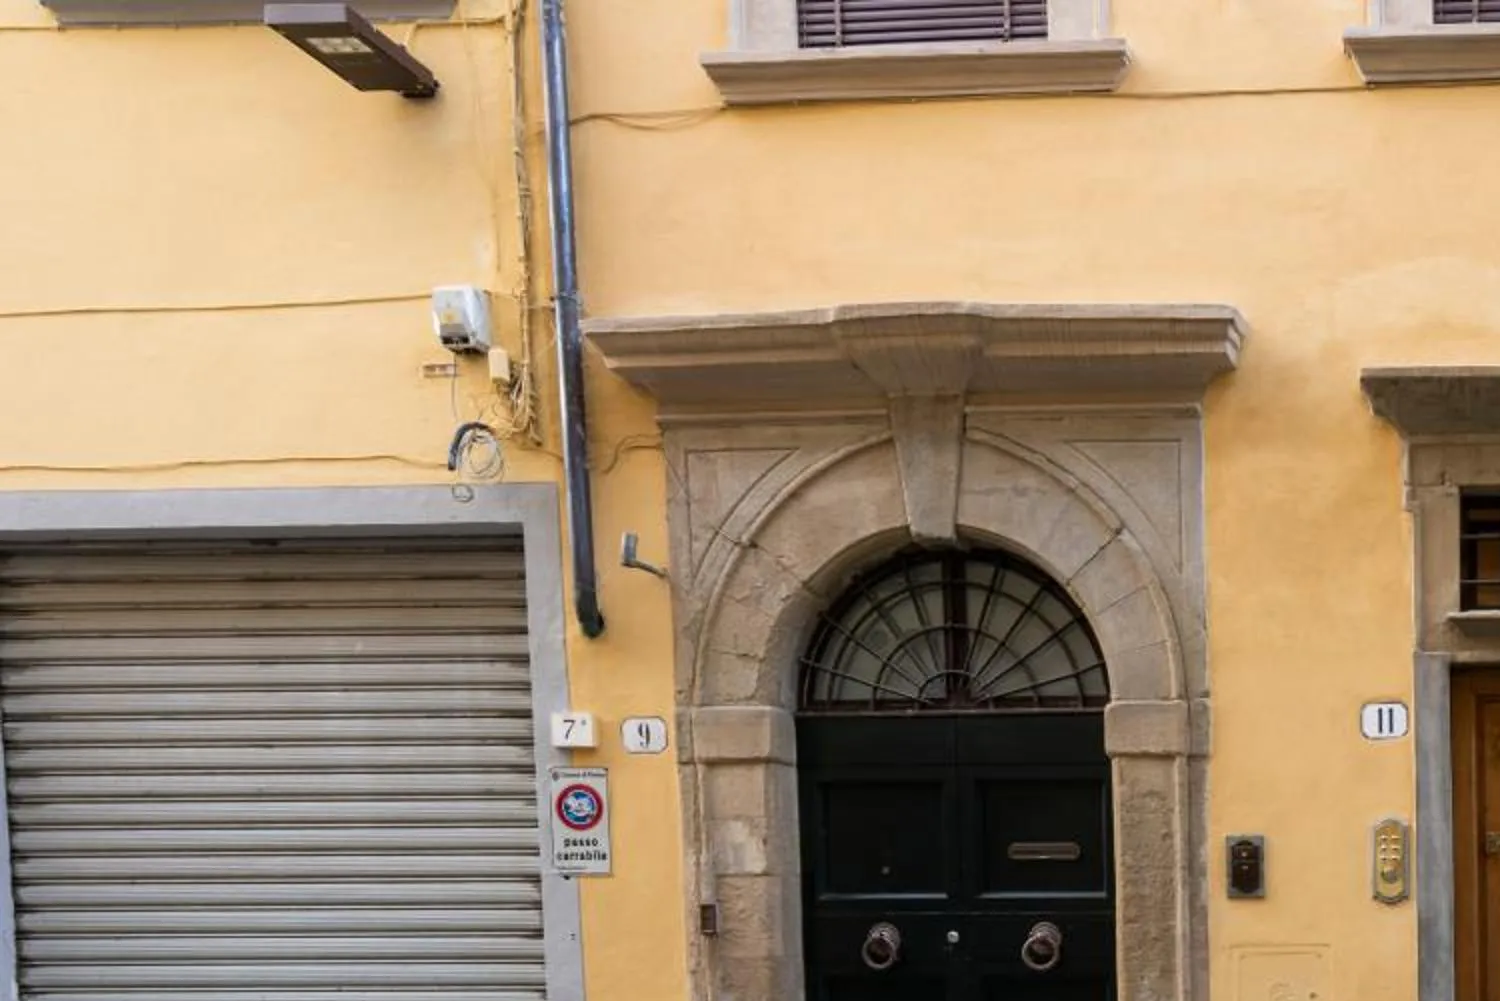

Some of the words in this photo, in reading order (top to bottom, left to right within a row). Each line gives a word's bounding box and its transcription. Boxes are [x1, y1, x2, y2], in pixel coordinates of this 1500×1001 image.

[1377, 707, 1394, 734] 11
[637, 722, 651, 747] 9
[563, 838, 598, 848] passo
[557, 850, 607, 860] carrabile
